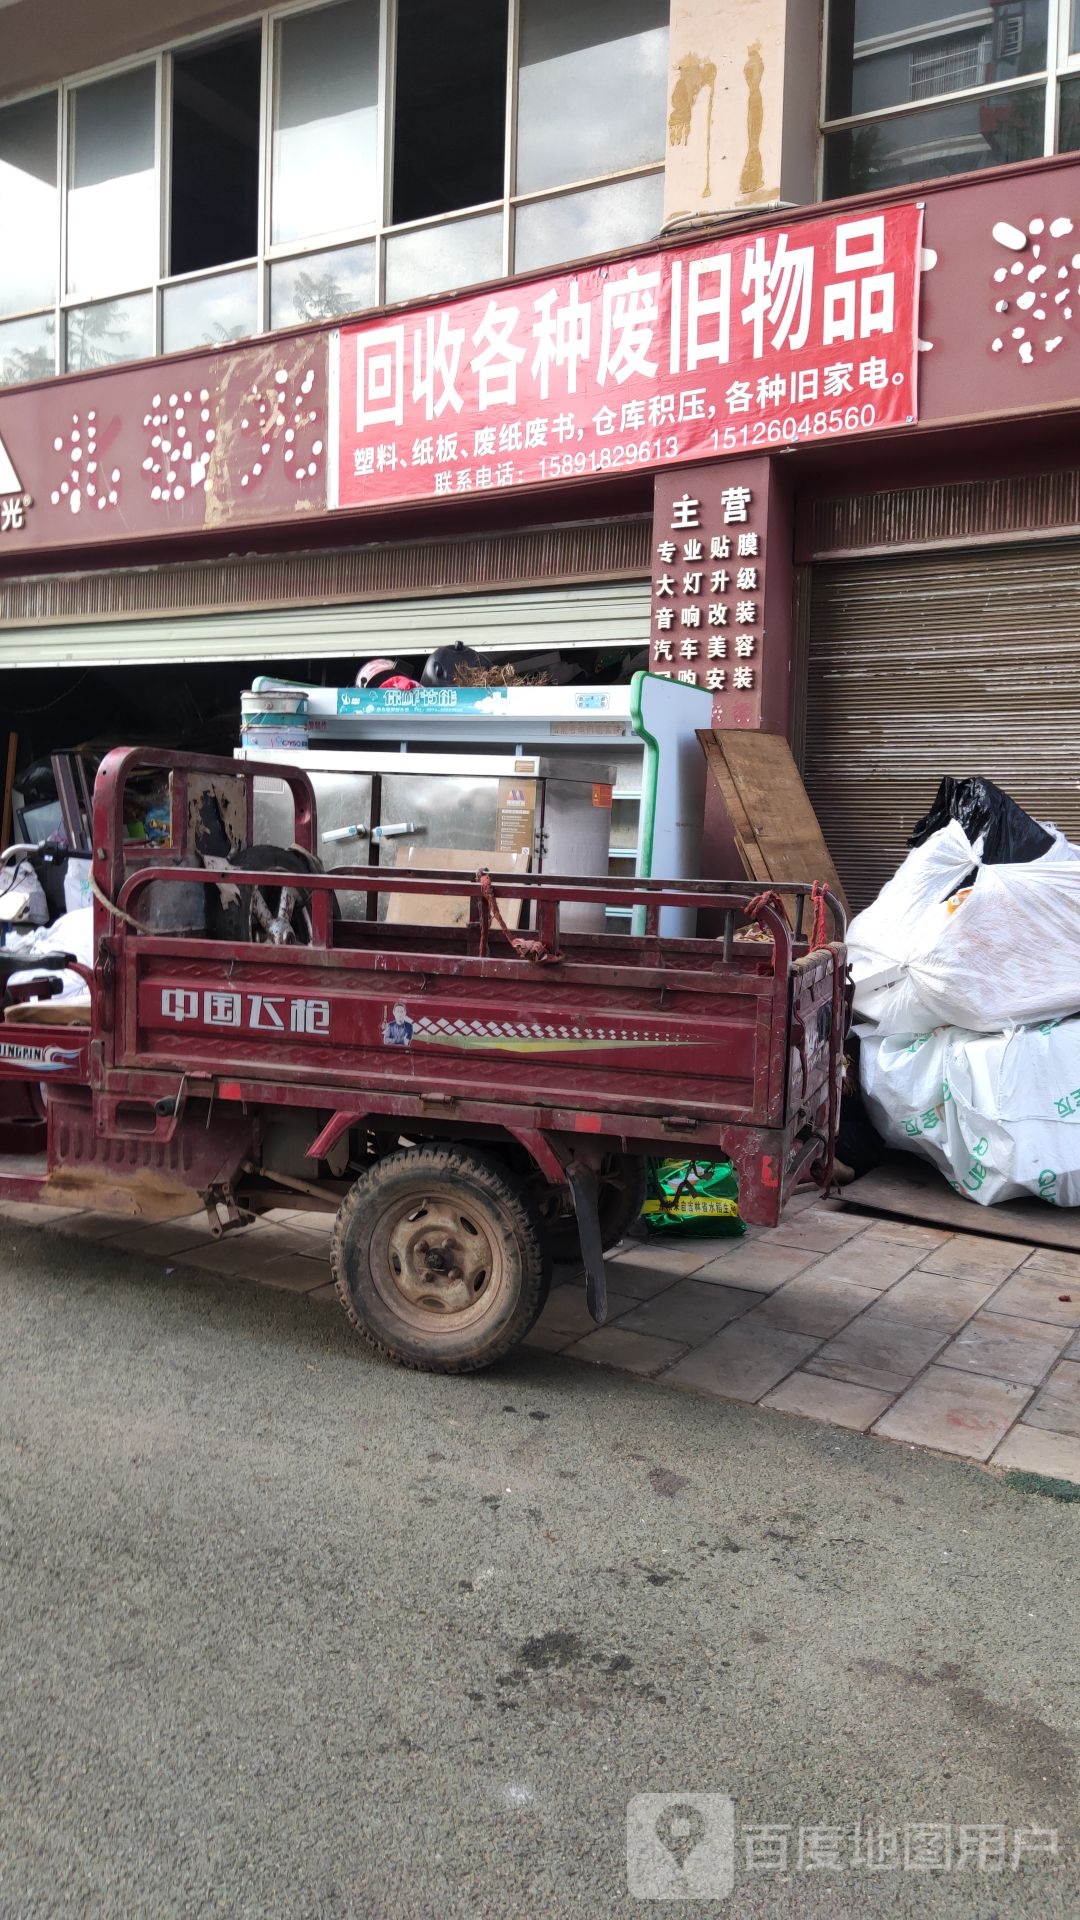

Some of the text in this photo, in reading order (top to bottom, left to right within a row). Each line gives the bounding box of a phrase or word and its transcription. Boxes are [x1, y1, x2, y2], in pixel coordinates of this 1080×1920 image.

[355, 216, 895, 433] 回收各种废旧物品
[433, 403, 876, 496] 联系电话： 15891829613 15126048560
[671, 486, 751, 529] 主营
[656, 532, 758, 563] 专业贴膜
[656, 567, 757, 597] 大灯升级
[655, 601, 755, 630] 音响改装
[653, 634, 754, 662] 汽车美容
[161, 988, 331, 1035] 中国飞枪
